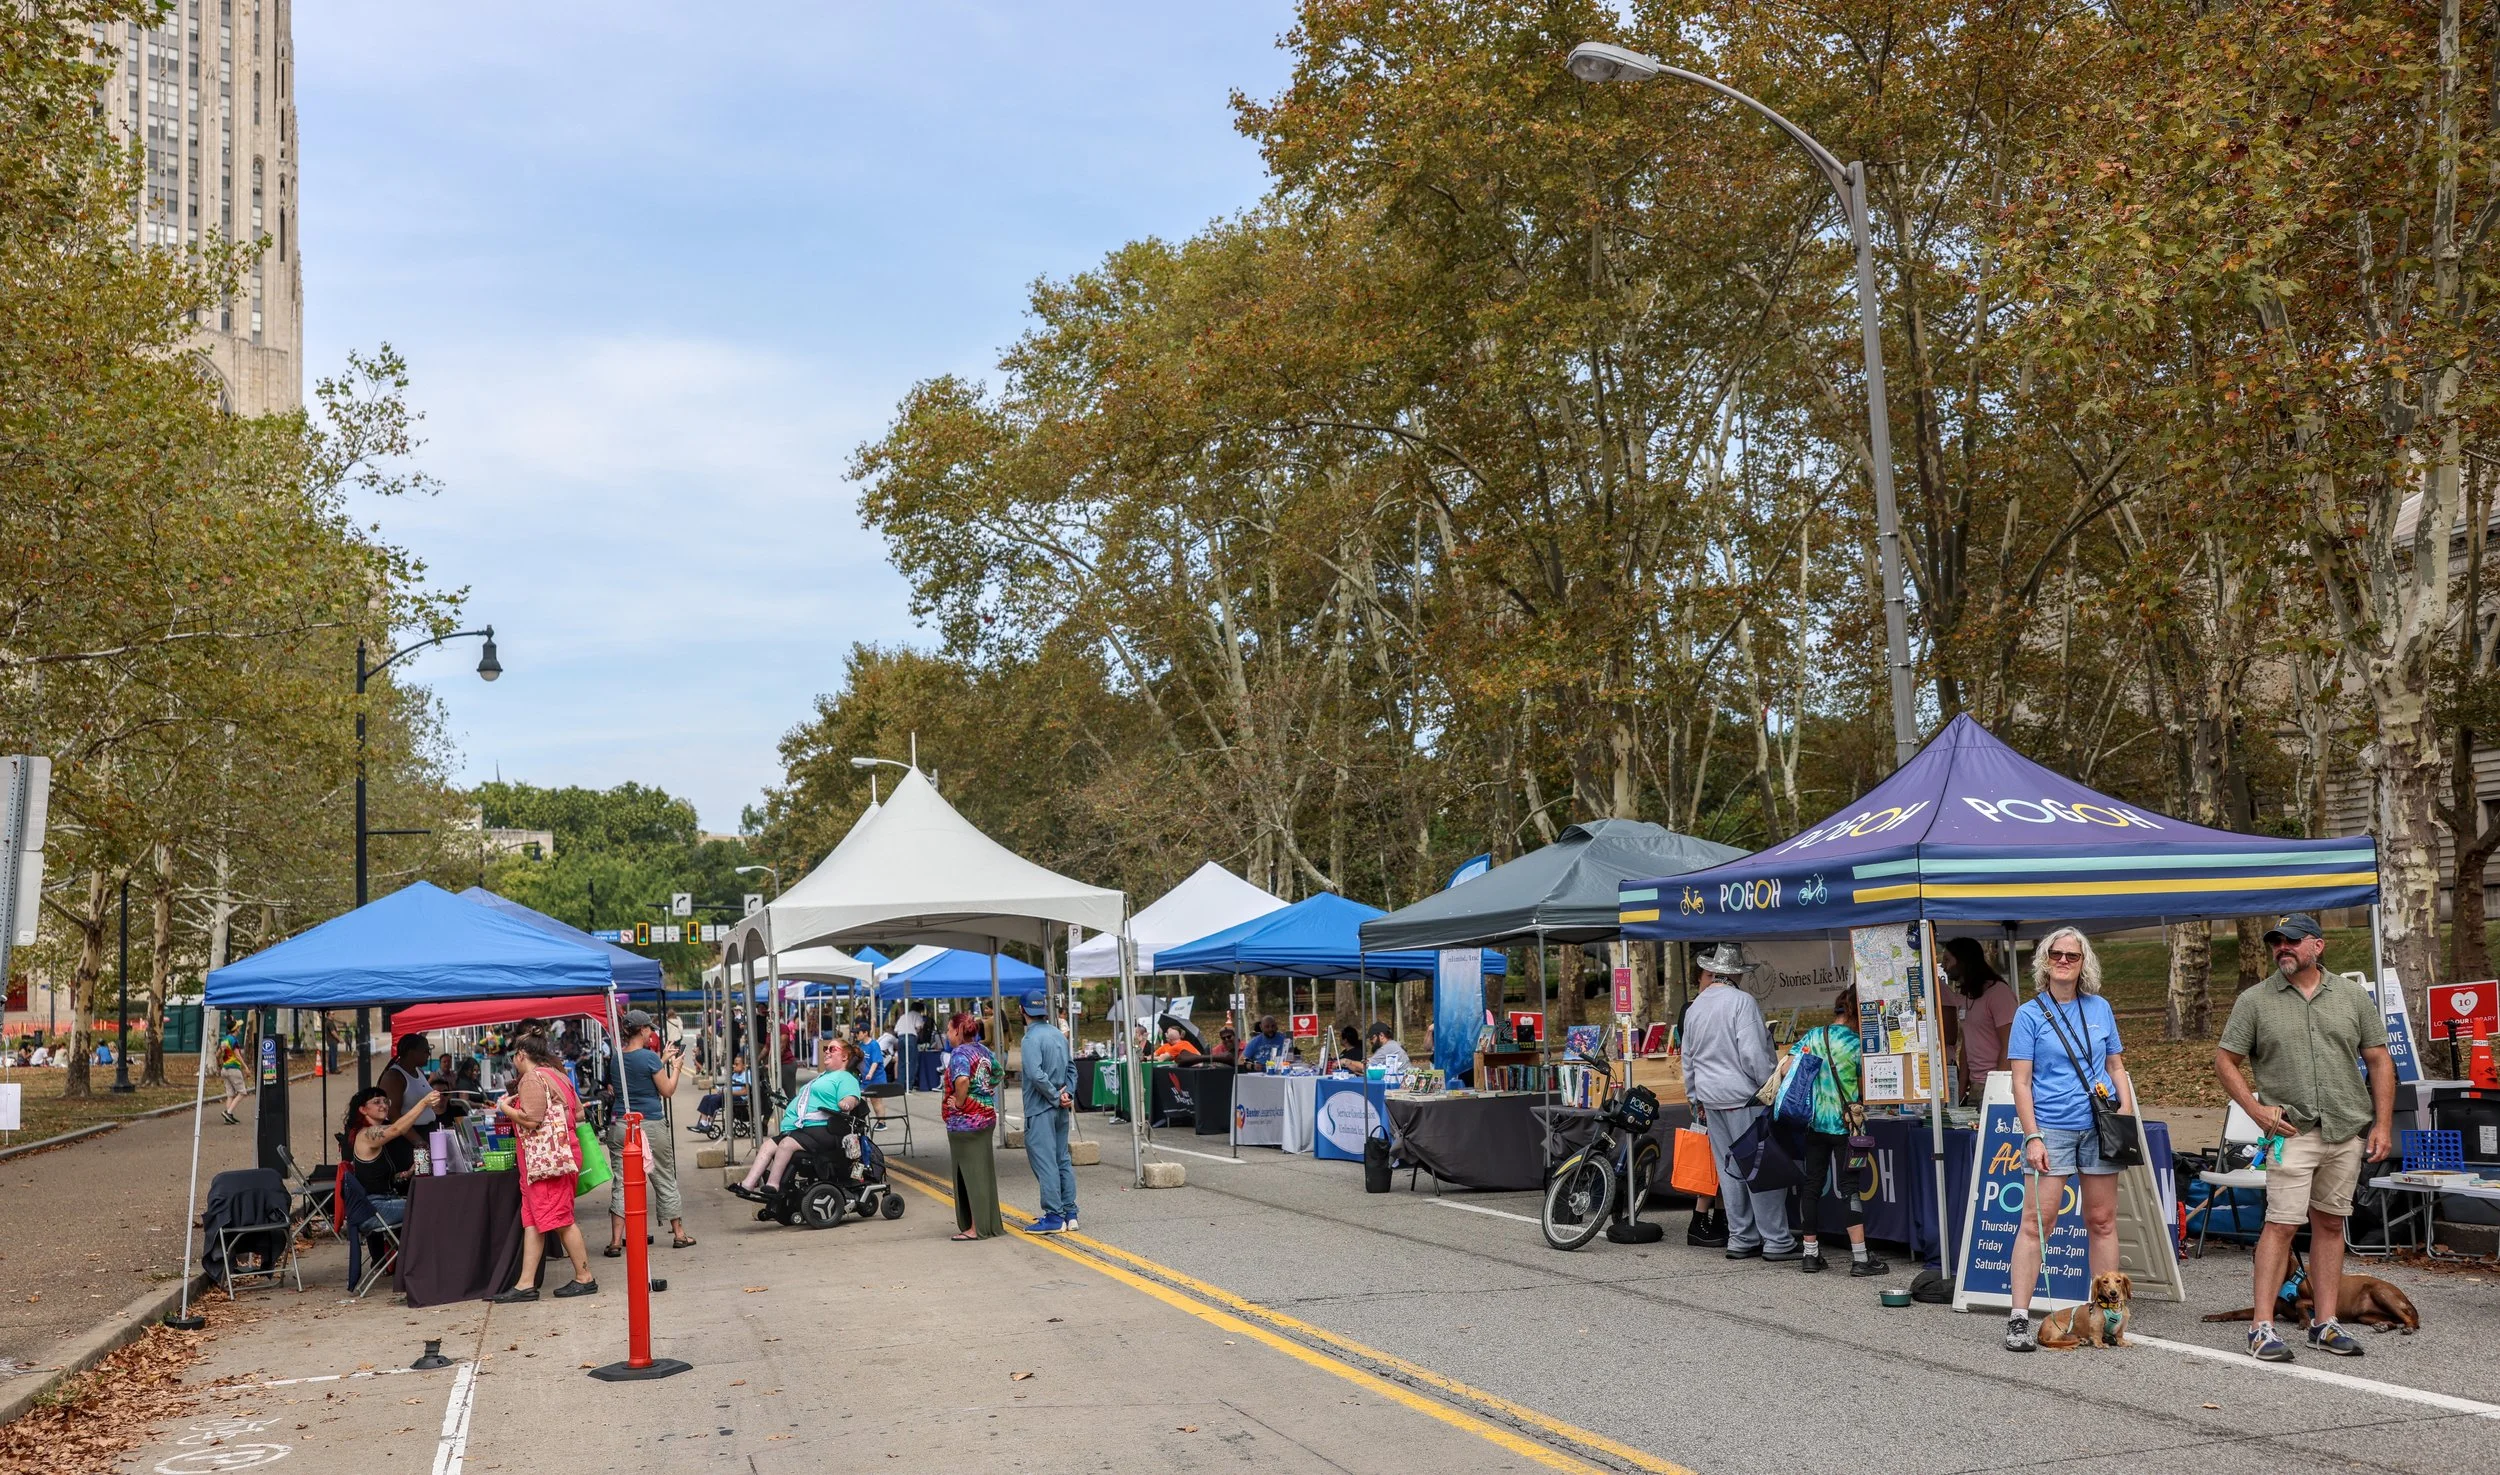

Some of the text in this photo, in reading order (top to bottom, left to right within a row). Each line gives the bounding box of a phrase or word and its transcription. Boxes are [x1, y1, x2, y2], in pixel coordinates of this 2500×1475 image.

[1961, 798, 2165, 829] POGOH
[1775, 800, 1930, 856] POGOH
[1720, 879, 1781, 912] POGOH
[1779, 972, 1811, 987] Stories
[1813, 968, 1833, 985] Like
[1630, 1096, 1654, 1115] POGOH
[1981, 1220, 2018, 1234] Thursday
[1978, 1239, 2003, 1253] Friday
[1975, 1258, 2011, 1273] Saturday
